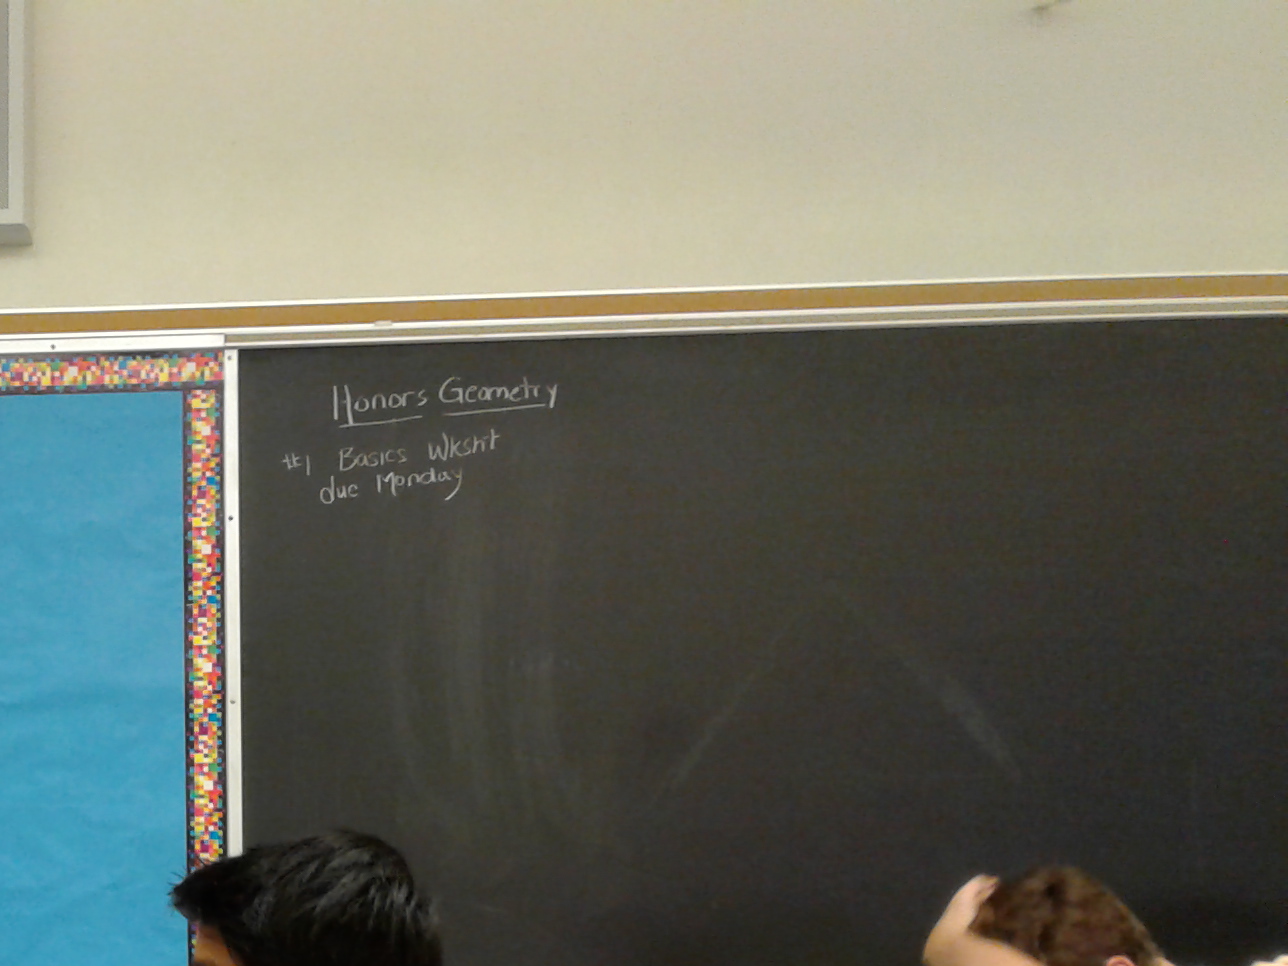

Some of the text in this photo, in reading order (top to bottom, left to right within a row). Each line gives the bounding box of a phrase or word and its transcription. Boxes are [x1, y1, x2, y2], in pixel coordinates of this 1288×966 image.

[332, 376, 558, 425] Honors Geometry
[281, 452, 311, 476] #1
[339, 447, 408, 472] Basics
[319, 467, 463, 504] due Monday
